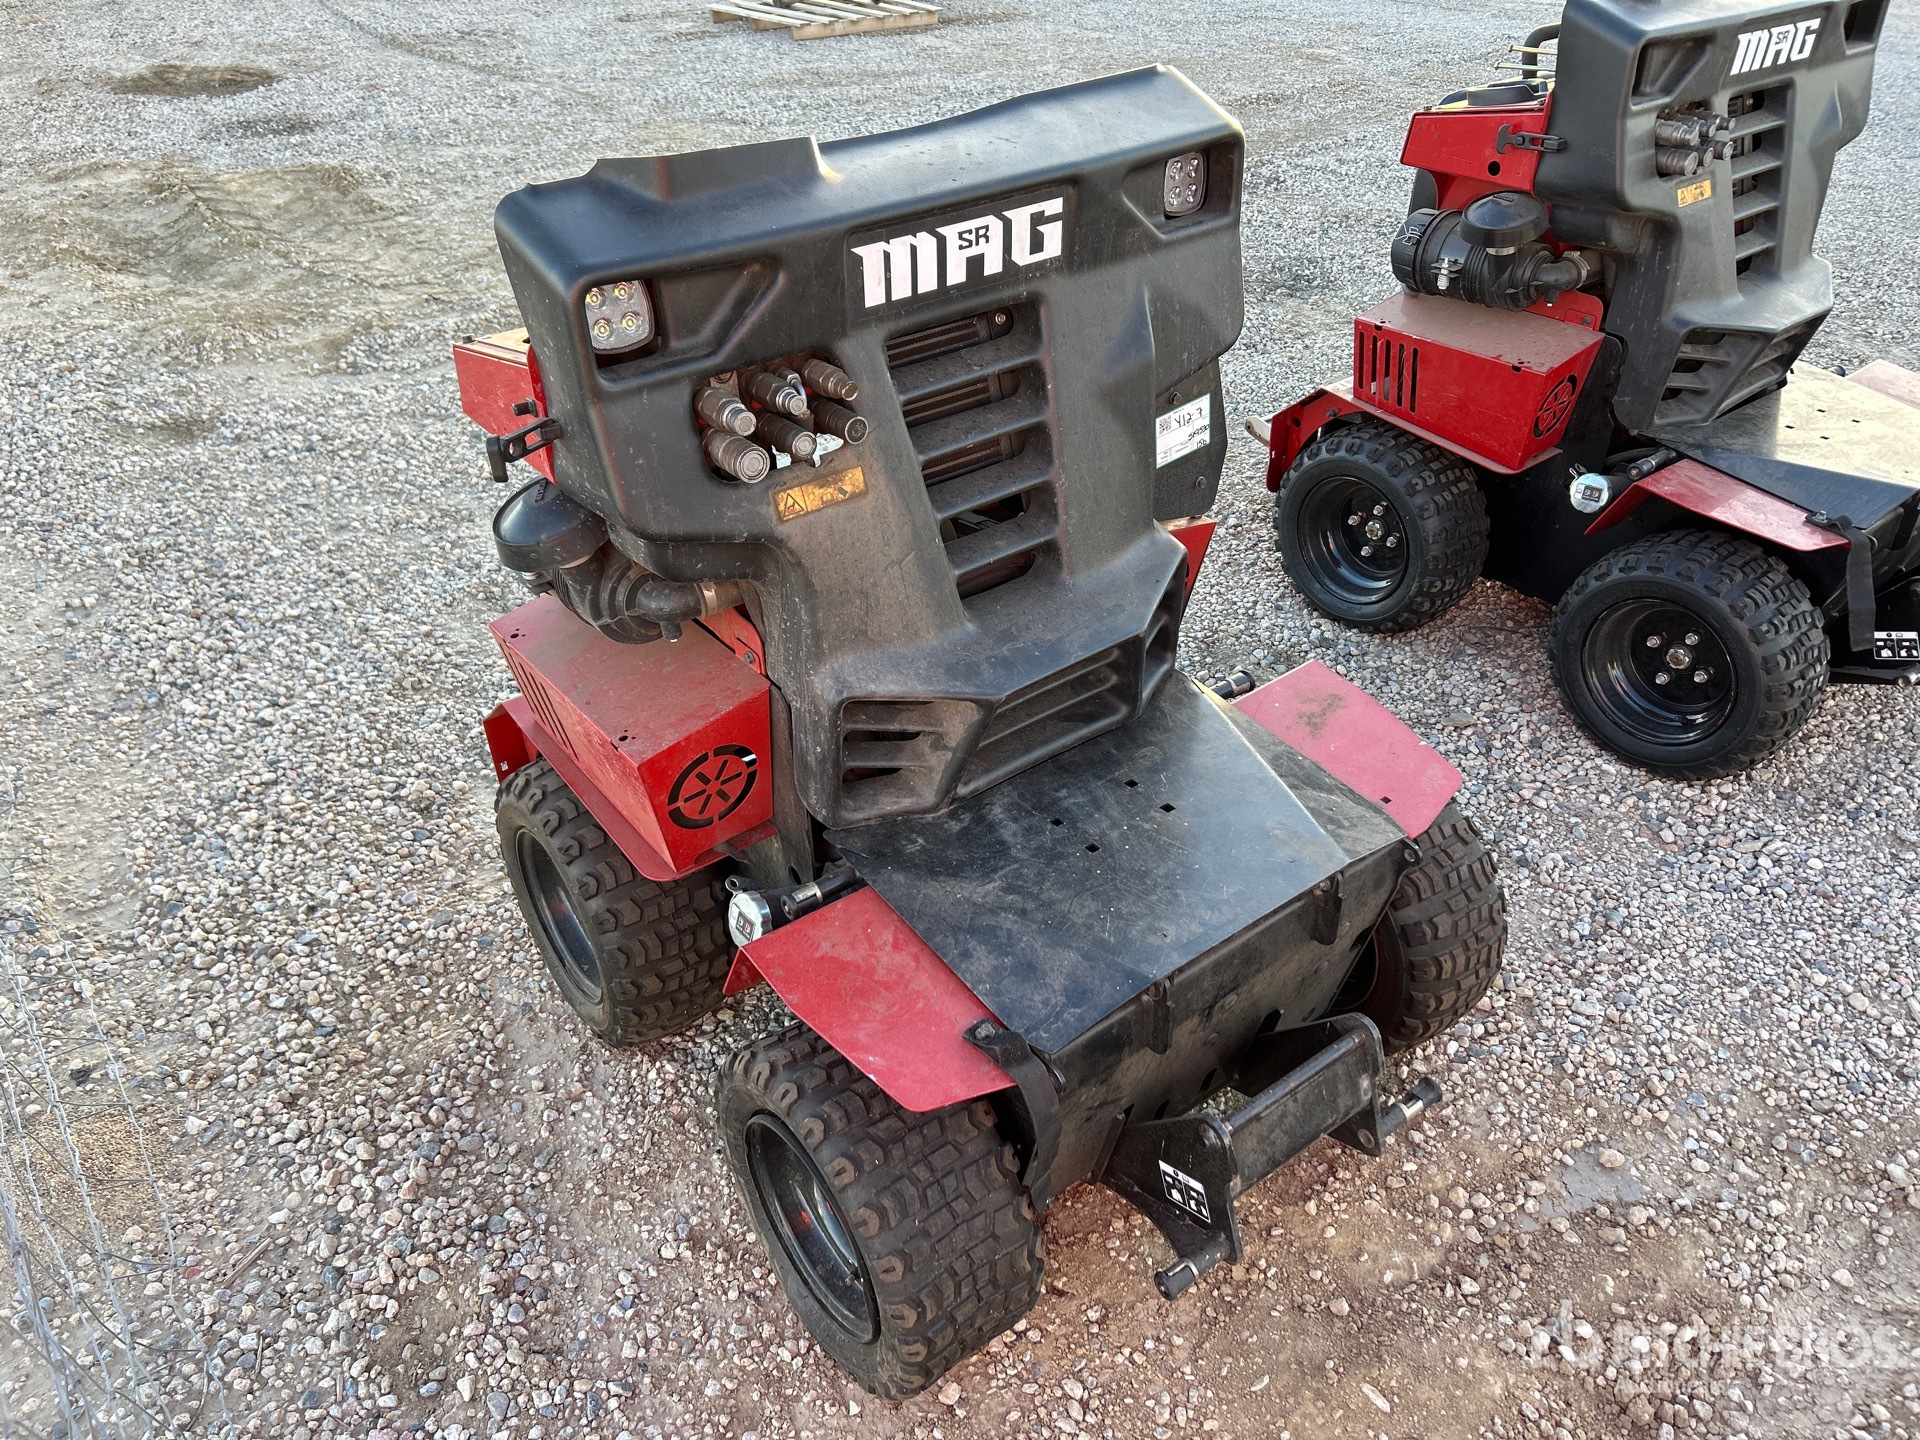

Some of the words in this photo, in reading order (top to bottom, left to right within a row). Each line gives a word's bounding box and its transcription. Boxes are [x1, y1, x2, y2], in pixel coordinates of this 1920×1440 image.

[1729, 17, 1821, 76] MAG
[1775, 29, 1791, 45] SR
[850, 196, 1063, 308] MAG
[957, 224, 990, 250] SR
